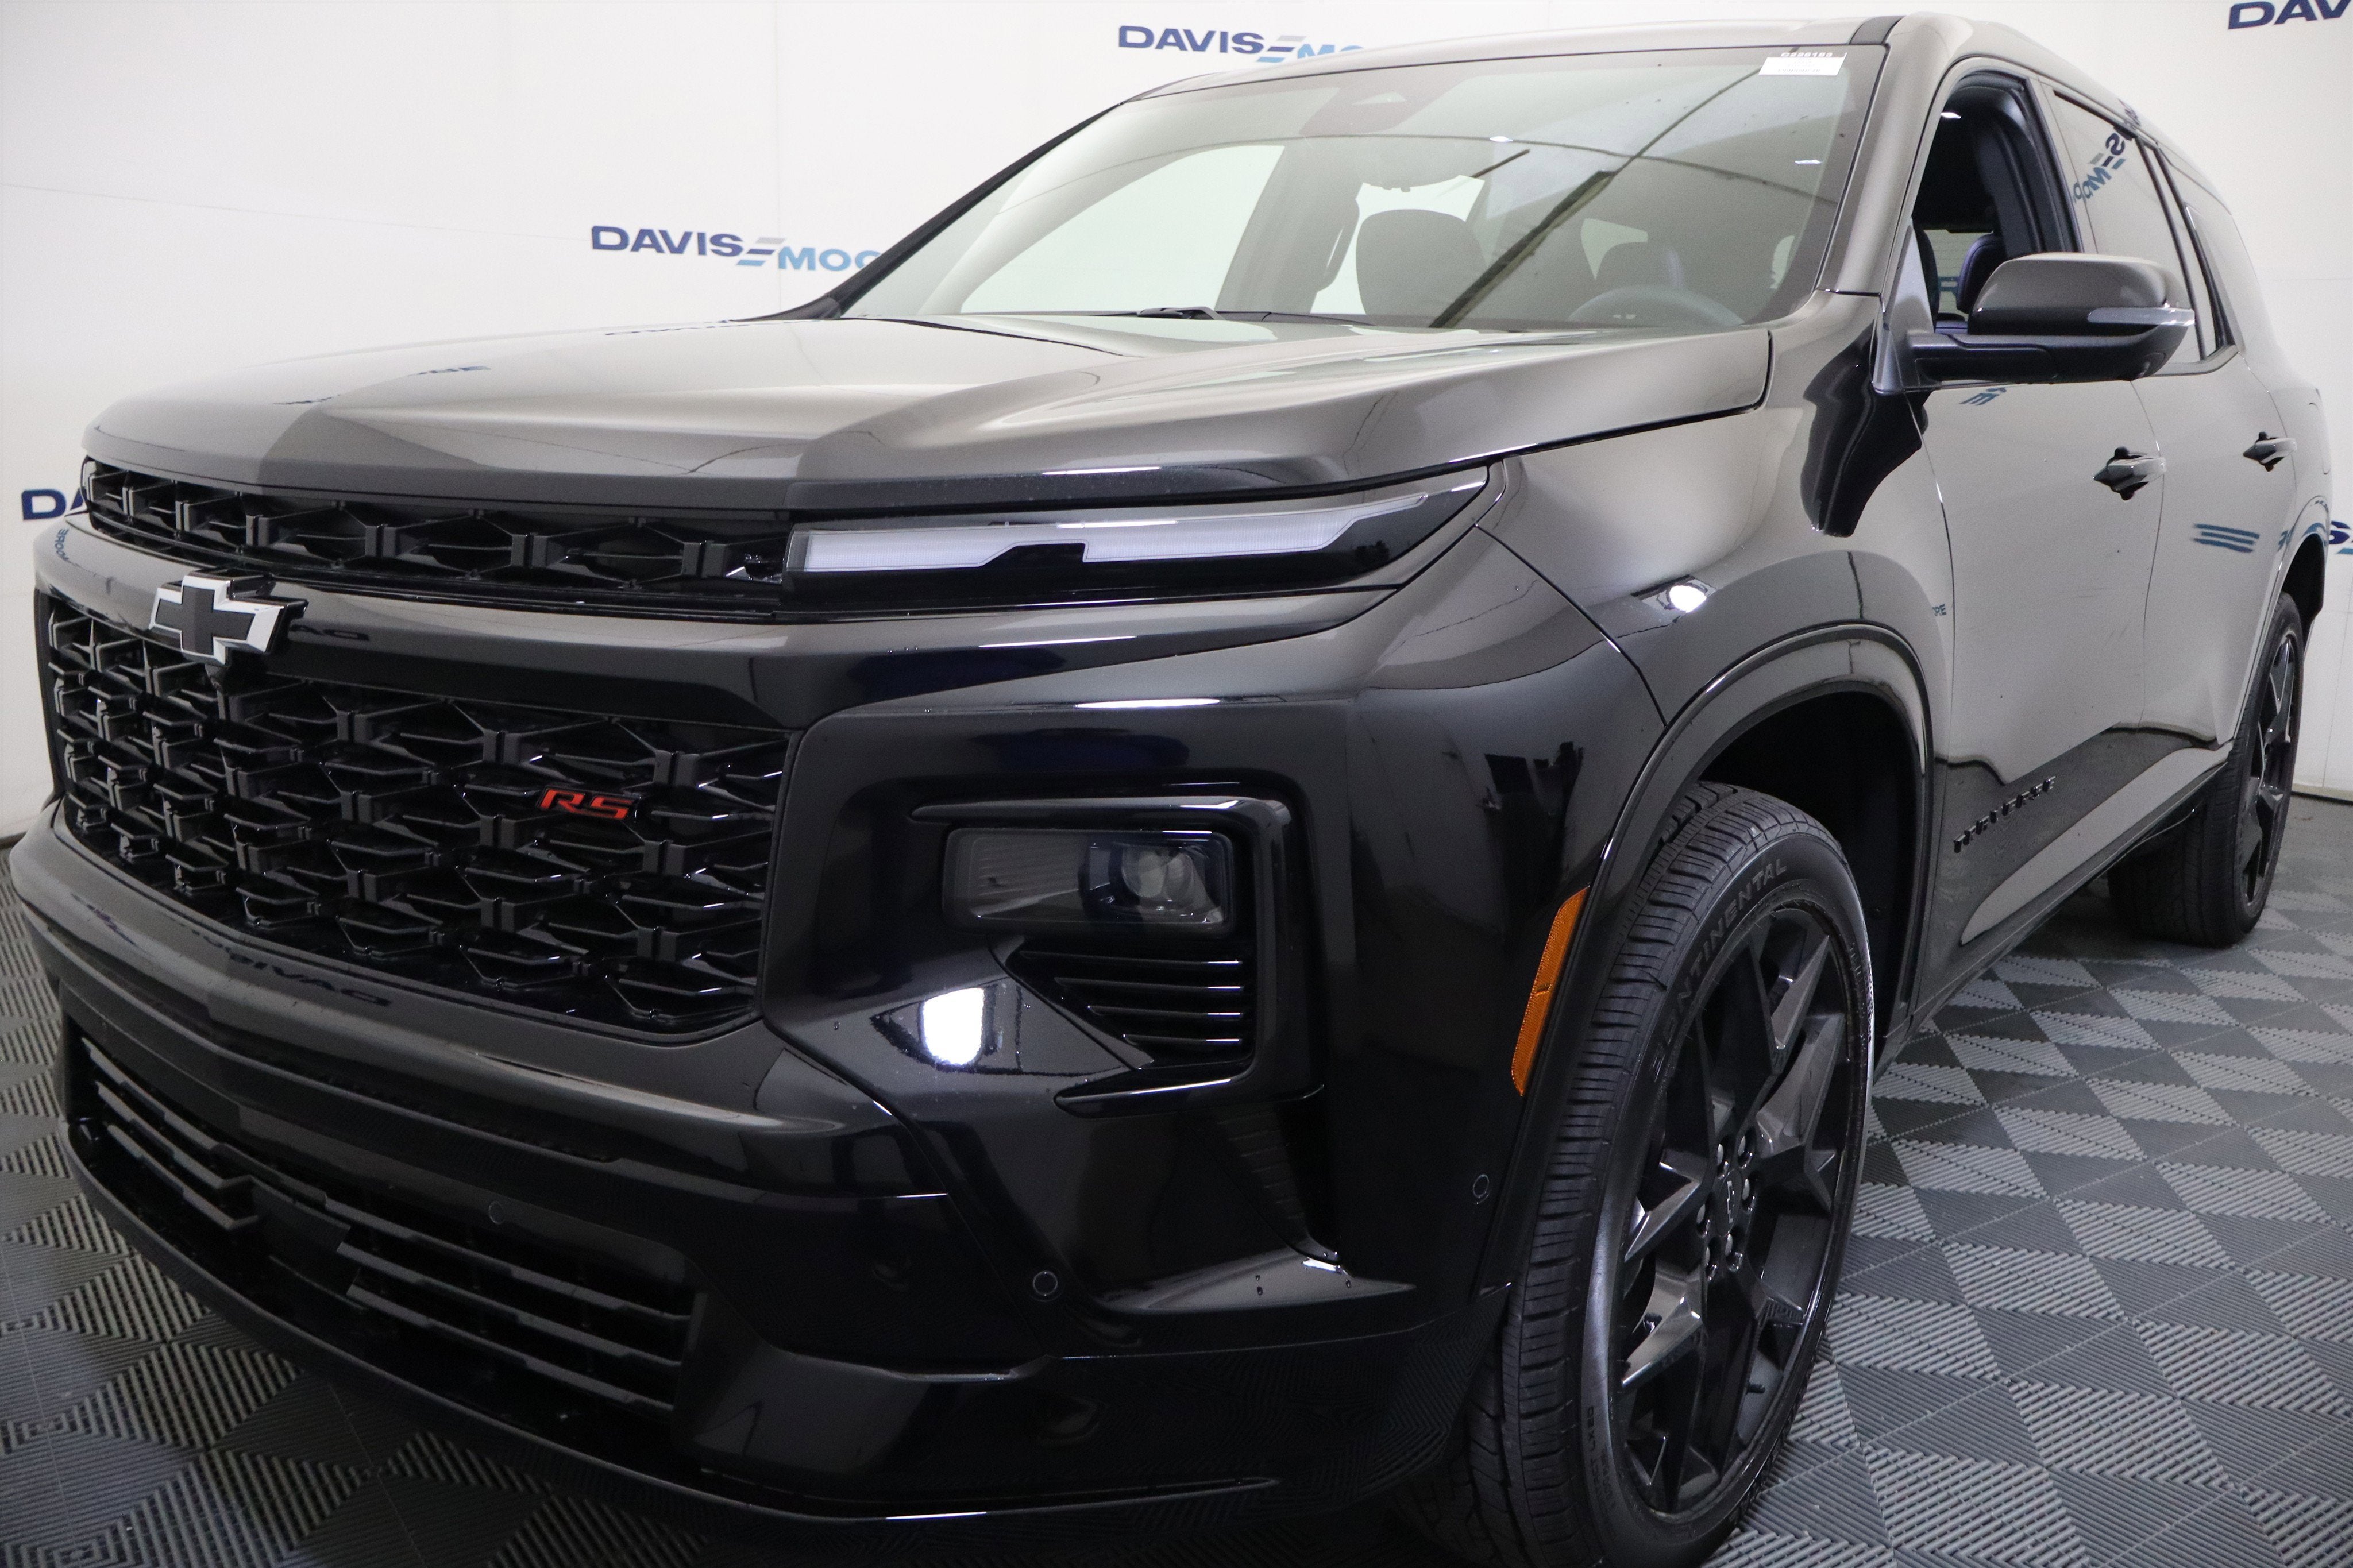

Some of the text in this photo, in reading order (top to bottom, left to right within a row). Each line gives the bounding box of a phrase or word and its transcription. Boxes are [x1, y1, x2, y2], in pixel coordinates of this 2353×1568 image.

[1118, 25, 1264, 54] DAVIS
[591, 226, 744, 257] DAVIS
[539, 788, 635, 820] RS
